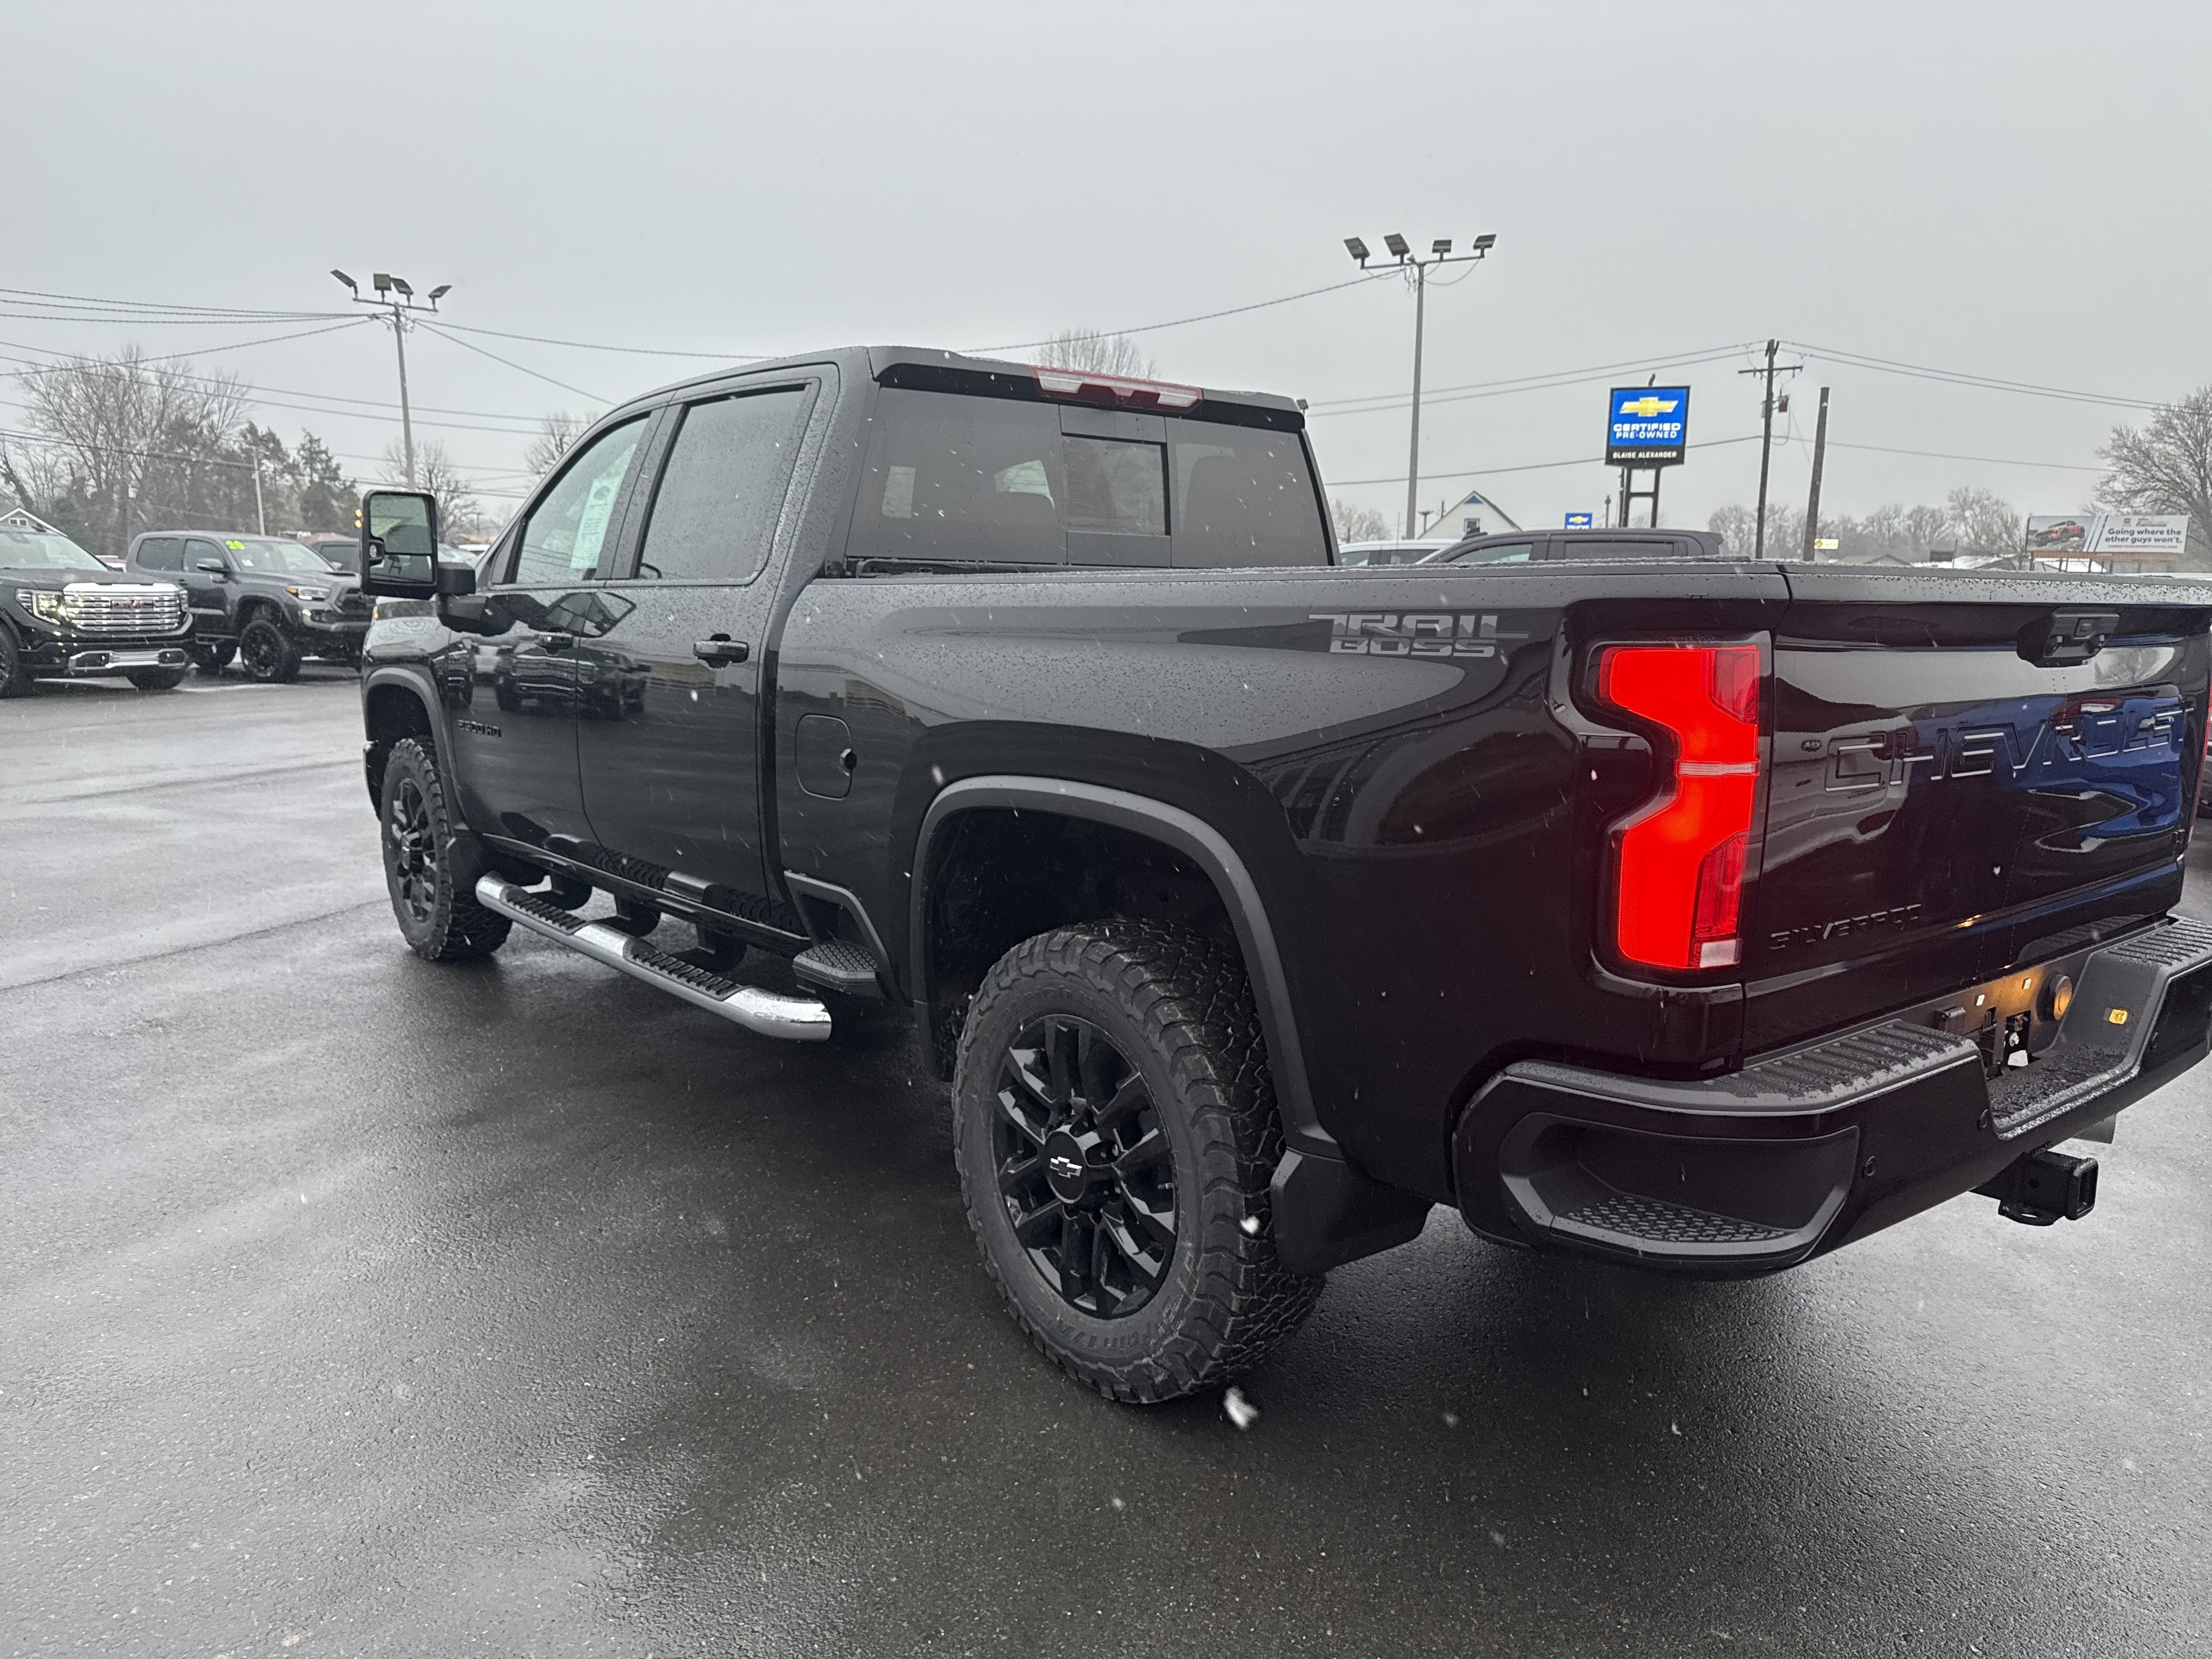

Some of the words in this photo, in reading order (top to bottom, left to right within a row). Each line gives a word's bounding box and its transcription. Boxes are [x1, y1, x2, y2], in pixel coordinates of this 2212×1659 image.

[1613, 422, 1681, 431] CERTIFIED
[1616, 431, 1677, 439] PRE-OWNED
[2108, 528, 2135, 536] Going
[225, 540, 246, 550] 20
[112, 600, 154, 608] GMC
[1308, 614, 1529, 639] TRAIL
[1330, 636, 1498, 658] BOSS
